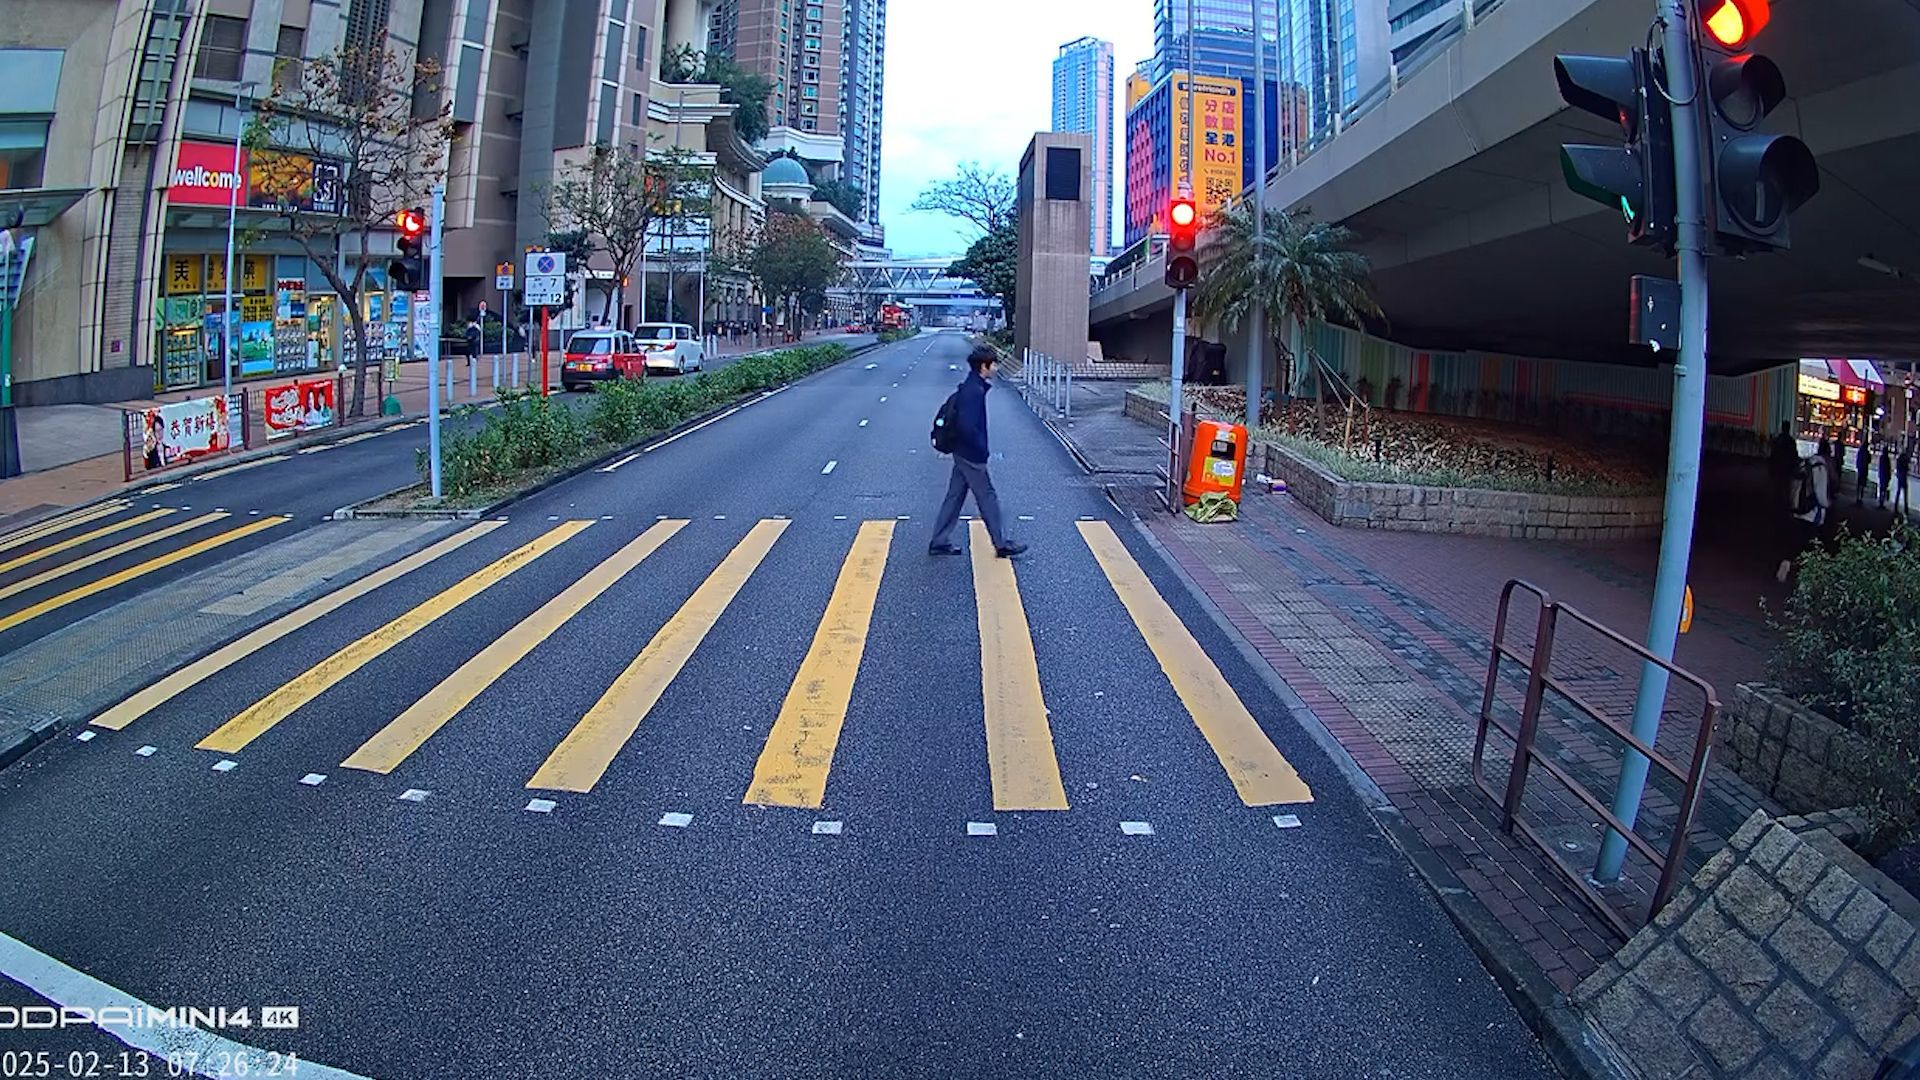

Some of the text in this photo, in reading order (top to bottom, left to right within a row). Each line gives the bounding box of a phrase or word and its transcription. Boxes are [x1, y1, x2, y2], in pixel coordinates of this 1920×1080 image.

[1205, 149, 1235, 164] No.1
[174, 164, 242, 190] wellcome
[550, 293, 562, 303] 12
[170, 411, 216, 439] 恭賀新禧
